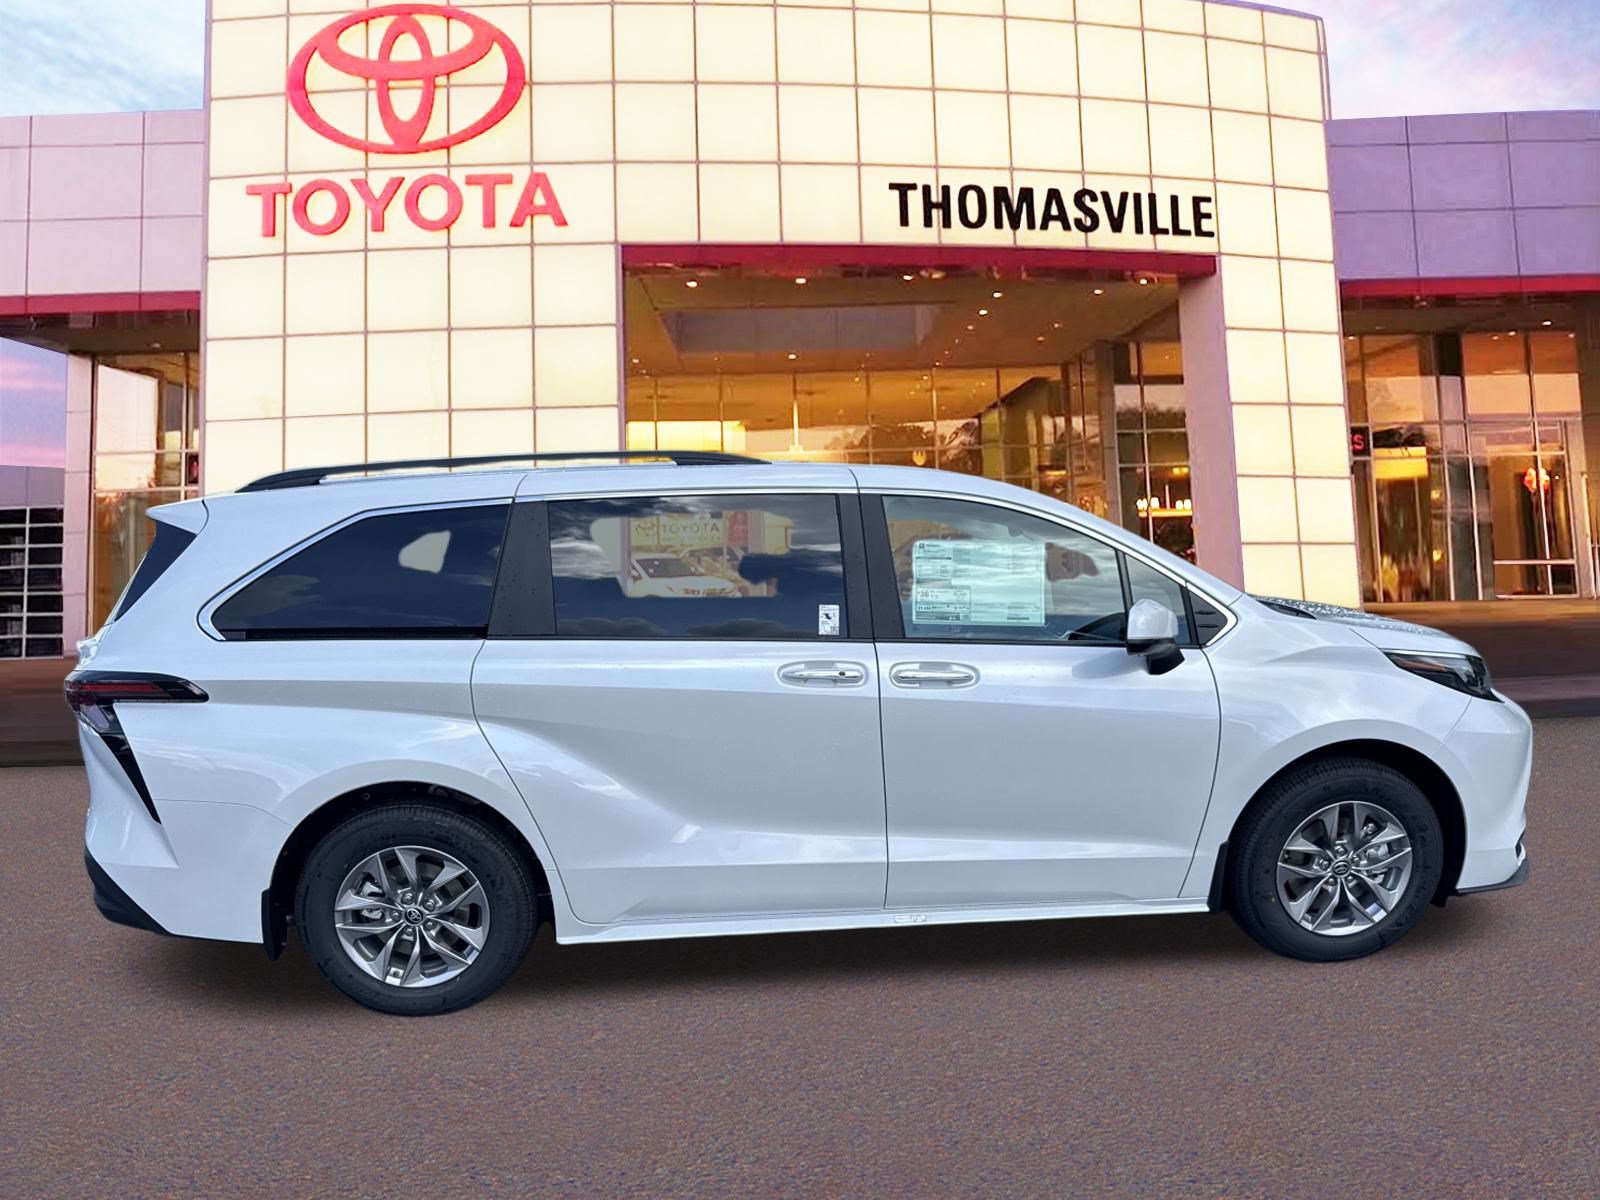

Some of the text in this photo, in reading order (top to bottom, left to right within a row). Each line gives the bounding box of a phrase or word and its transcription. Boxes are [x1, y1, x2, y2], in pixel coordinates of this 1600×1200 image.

[246, 172, 568, 237] TOYOTA
[888, 182, 1215, 238] THOMASVILLE
[661, 522, 720, 534] TOYOTA
